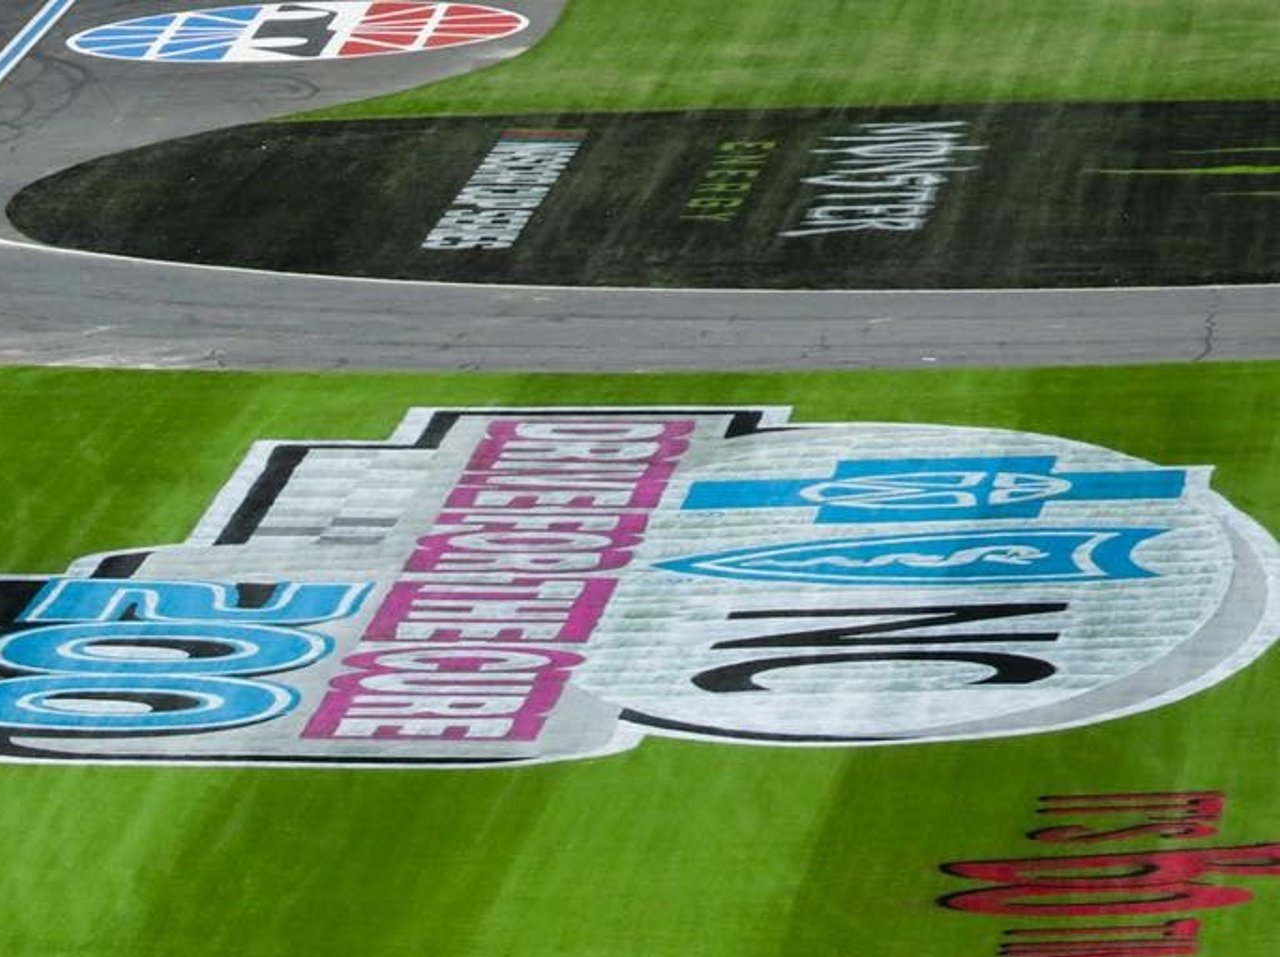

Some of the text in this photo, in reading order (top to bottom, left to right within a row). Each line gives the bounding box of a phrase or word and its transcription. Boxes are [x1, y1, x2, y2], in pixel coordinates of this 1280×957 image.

[472, 142, 581, 186] NASCAR
[680, 140, 777, 222] ENERGY
[777, 121, 989, 237] MONSTER
[420, 208, 538, 250] SERIES
[340, 421, 669, 739] DRIVE FOR THE CURE
[690, 602, 1068, 692] NC
